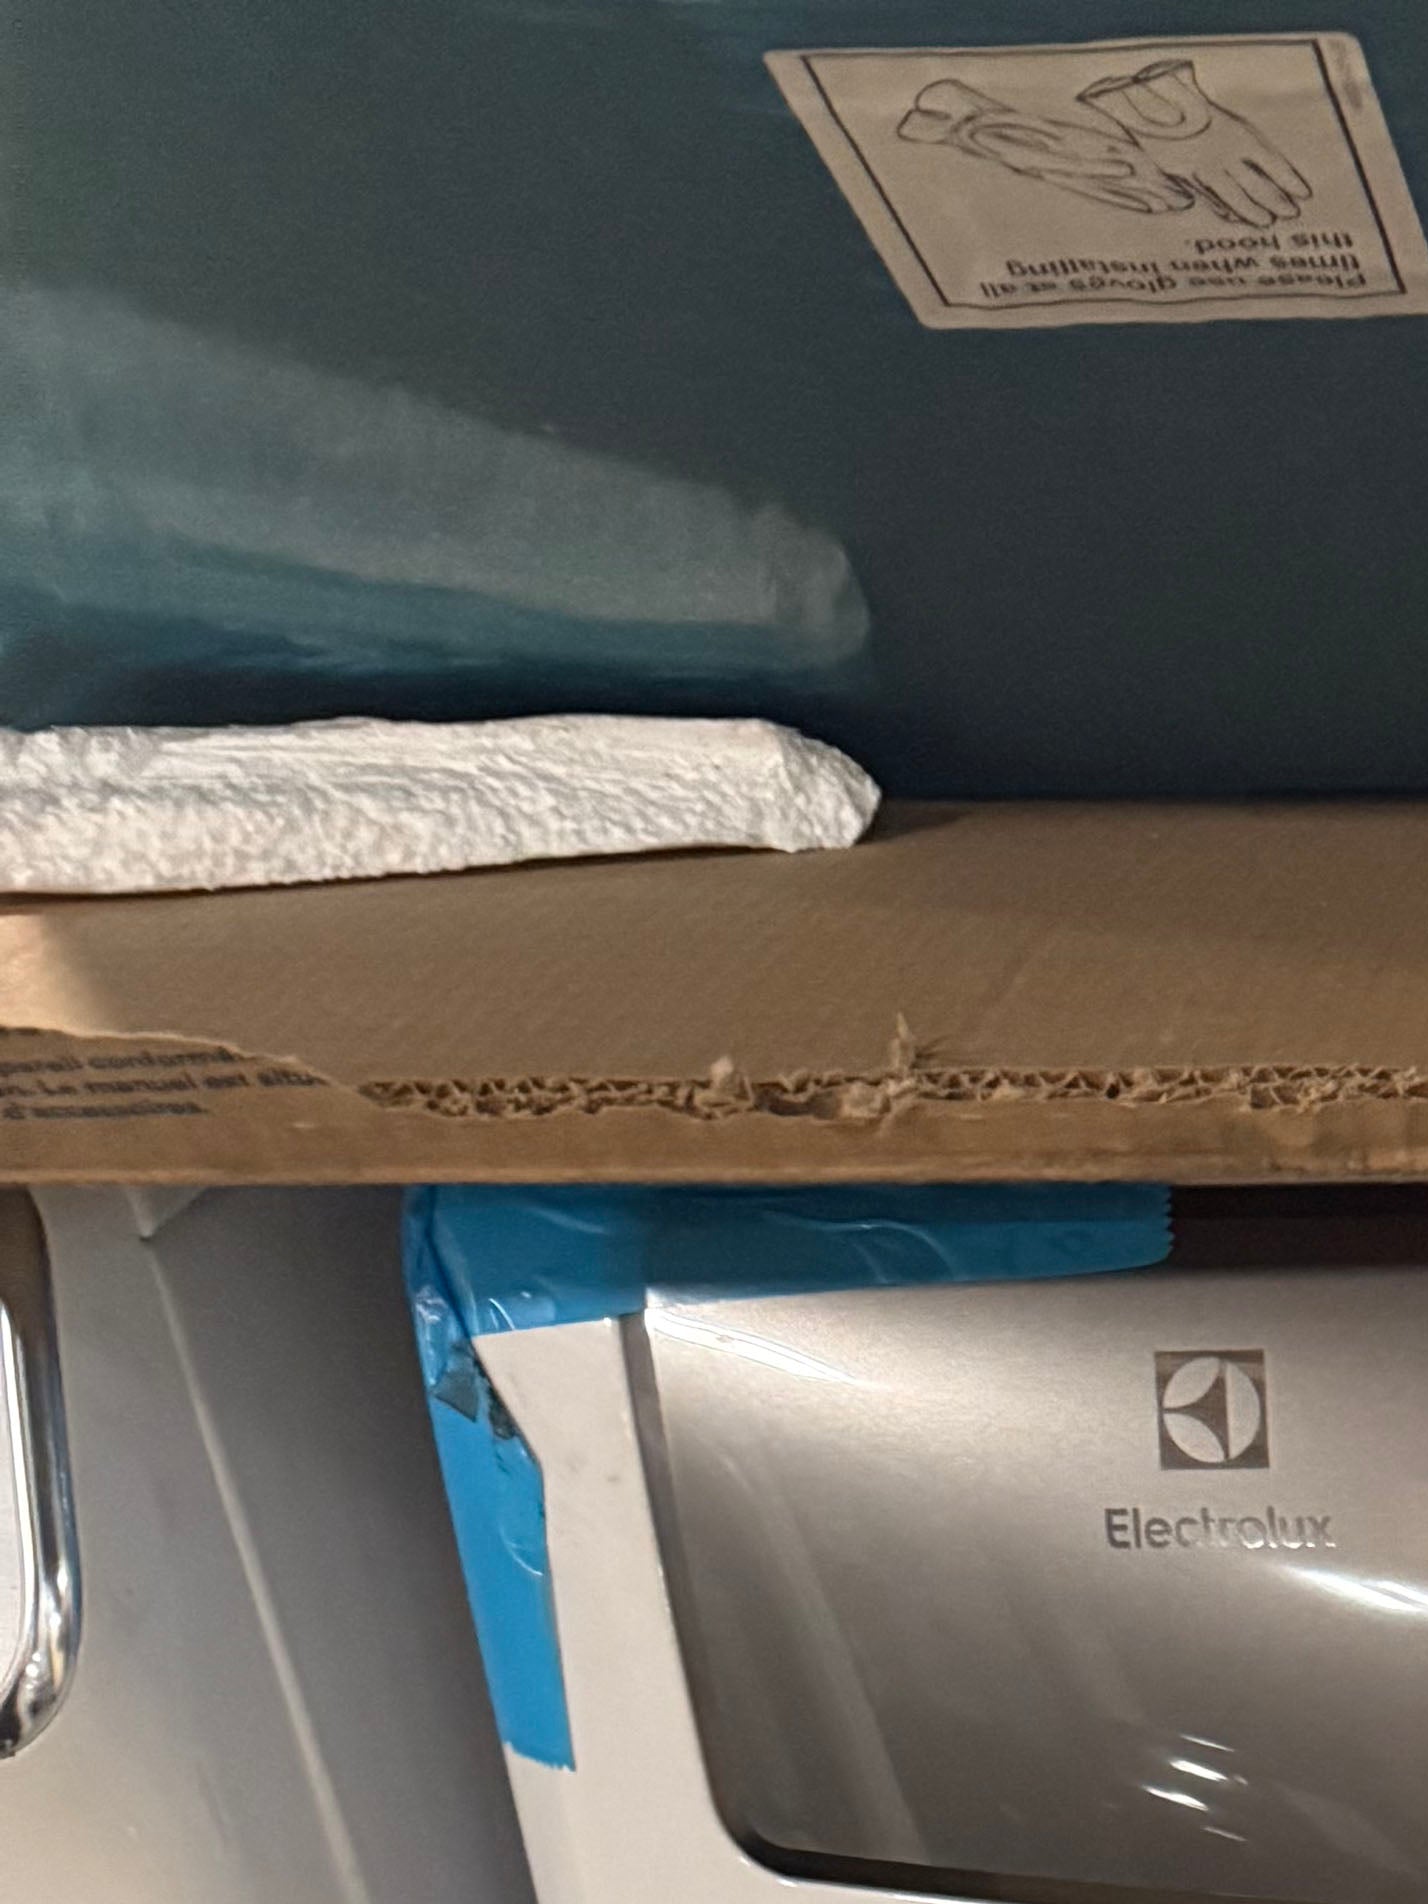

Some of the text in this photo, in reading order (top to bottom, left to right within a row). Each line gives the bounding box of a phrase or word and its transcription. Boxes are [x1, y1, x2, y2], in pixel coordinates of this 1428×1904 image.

[1289, 231, 1354, 249] this
[1005, 253, 1360, 280] times when installing
[979, 281, 1018, 298] all
[1068, 273, 1177, 294] gloves
[1104, 1506, 1337, 1551] Electrolux
